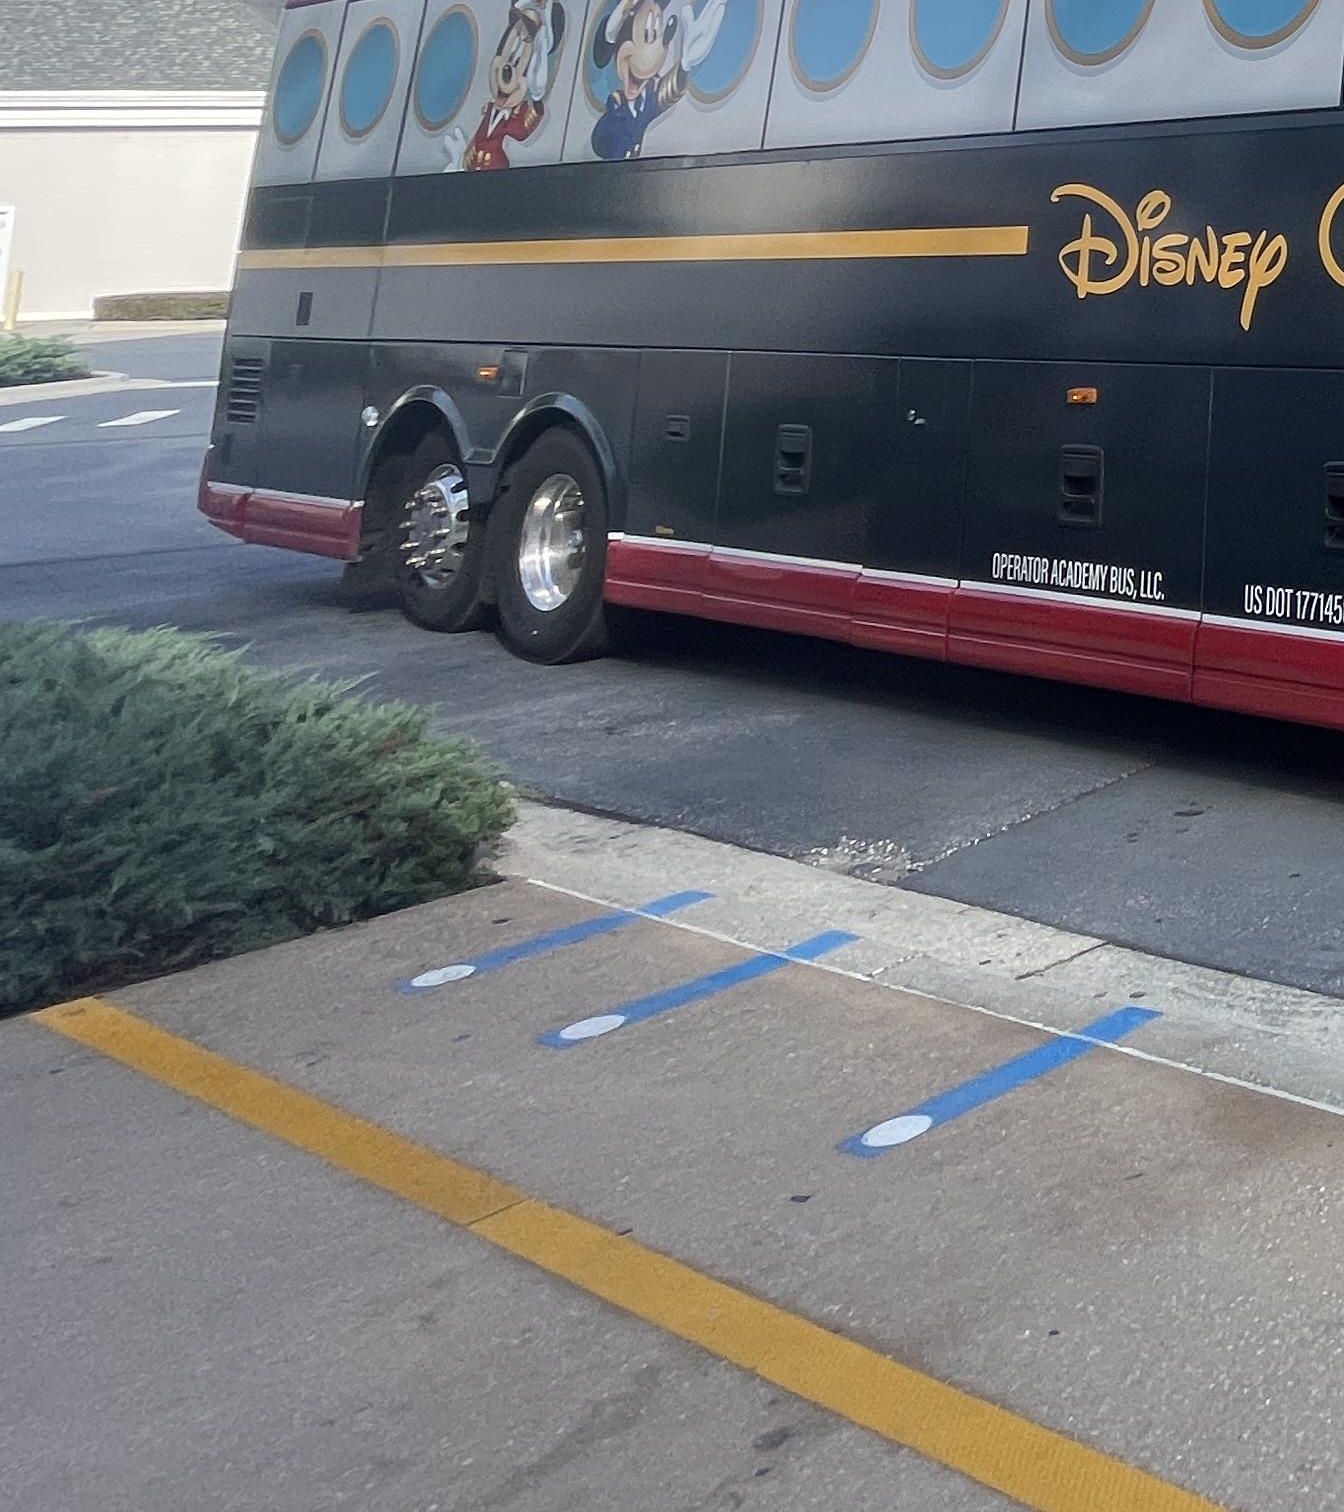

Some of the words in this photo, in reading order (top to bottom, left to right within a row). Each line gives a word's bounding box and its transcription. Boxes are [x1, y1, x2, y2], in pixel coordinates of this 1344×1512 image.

[992, 552, 1049, 585] OPERATOR
[1050, 559, 1108, 592] ACADEMY
[1109, 566, 1137, 600] BUS,
[1139, 570, 1165, 601] LLC.
[1244, 584, 1263, 614] US
[1265, 587, 1293, 618] DOT
